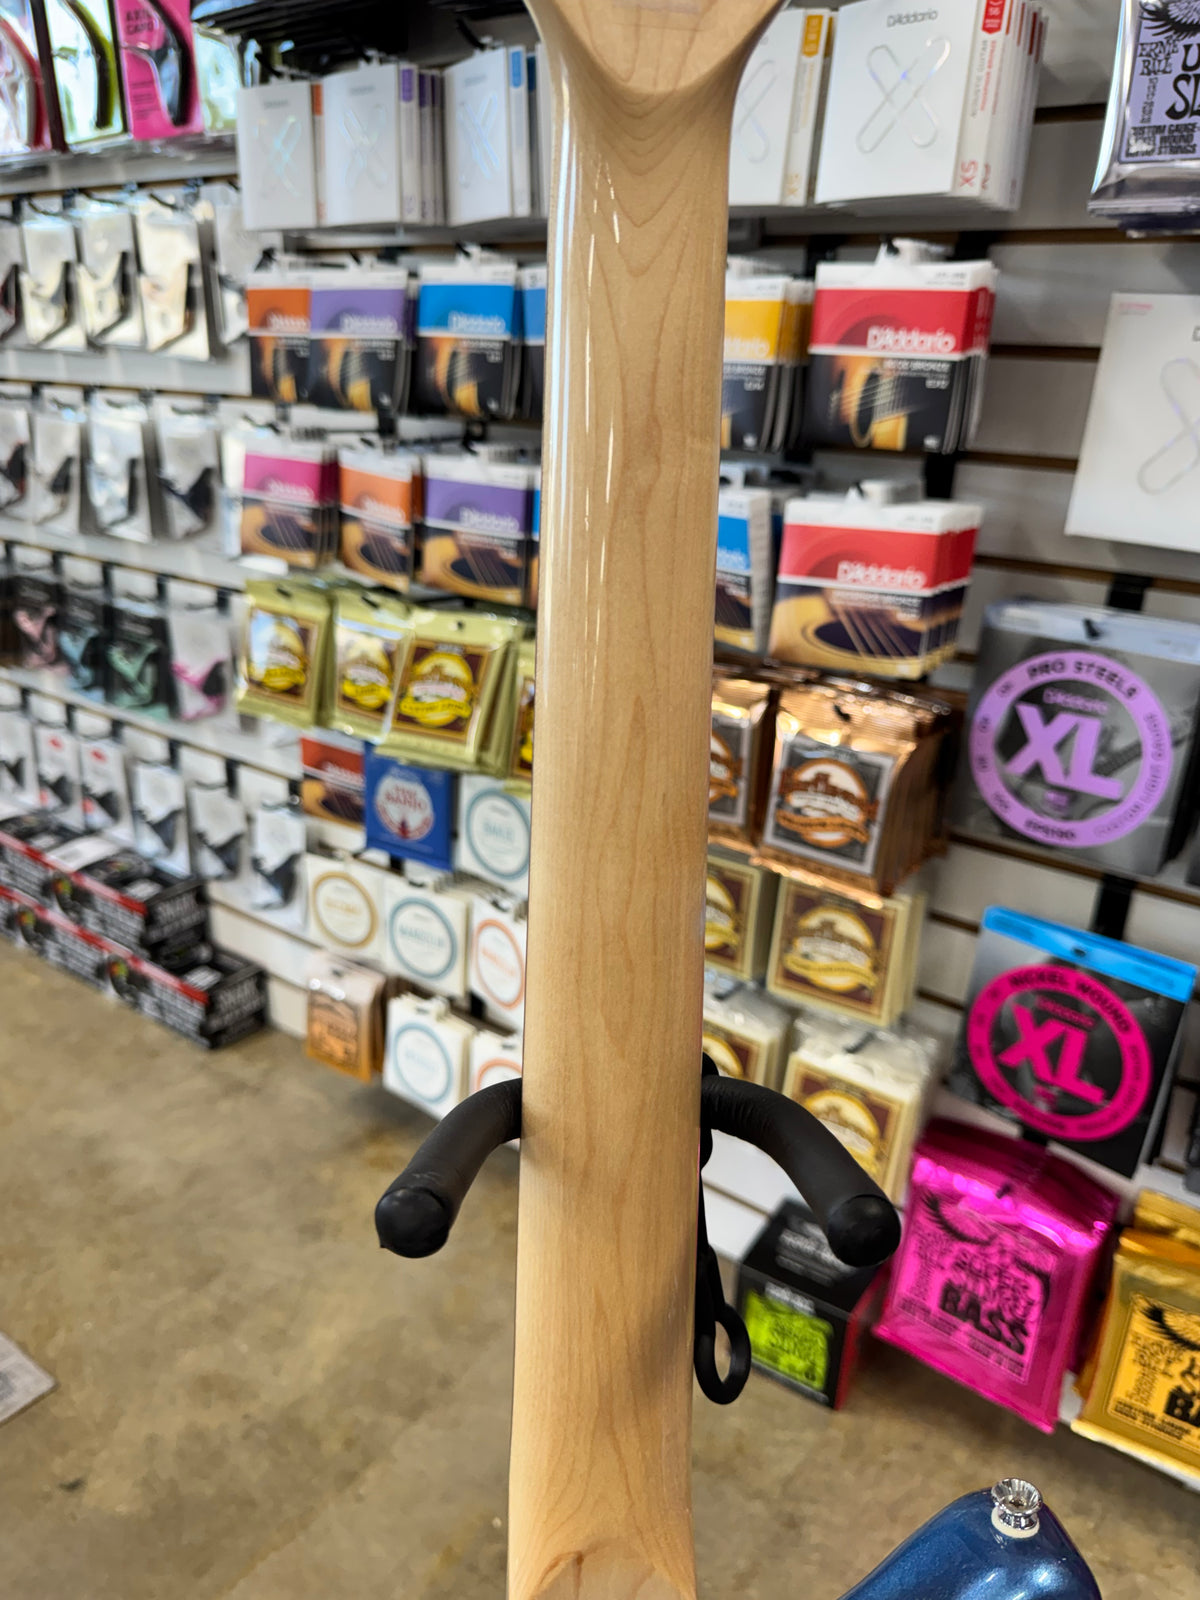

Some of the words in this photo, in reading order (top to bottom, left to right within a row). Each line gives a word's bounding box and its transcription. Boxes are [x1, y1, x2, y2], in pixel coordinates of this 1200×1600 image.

[1139, 35, 1179, 57] ERNIE
[1140, 58, 1173, 76] BALL
[1028, 658, 1066, 680] PRO
[1074, 661, 1139, 700] STEELS
[1004, 701, 1123, 800] XL
[1075, 980, 1132, 1034] WOUND
[997, 1001, 1107, 1106] XL
[1163, 1384, 1200, 1429] B
